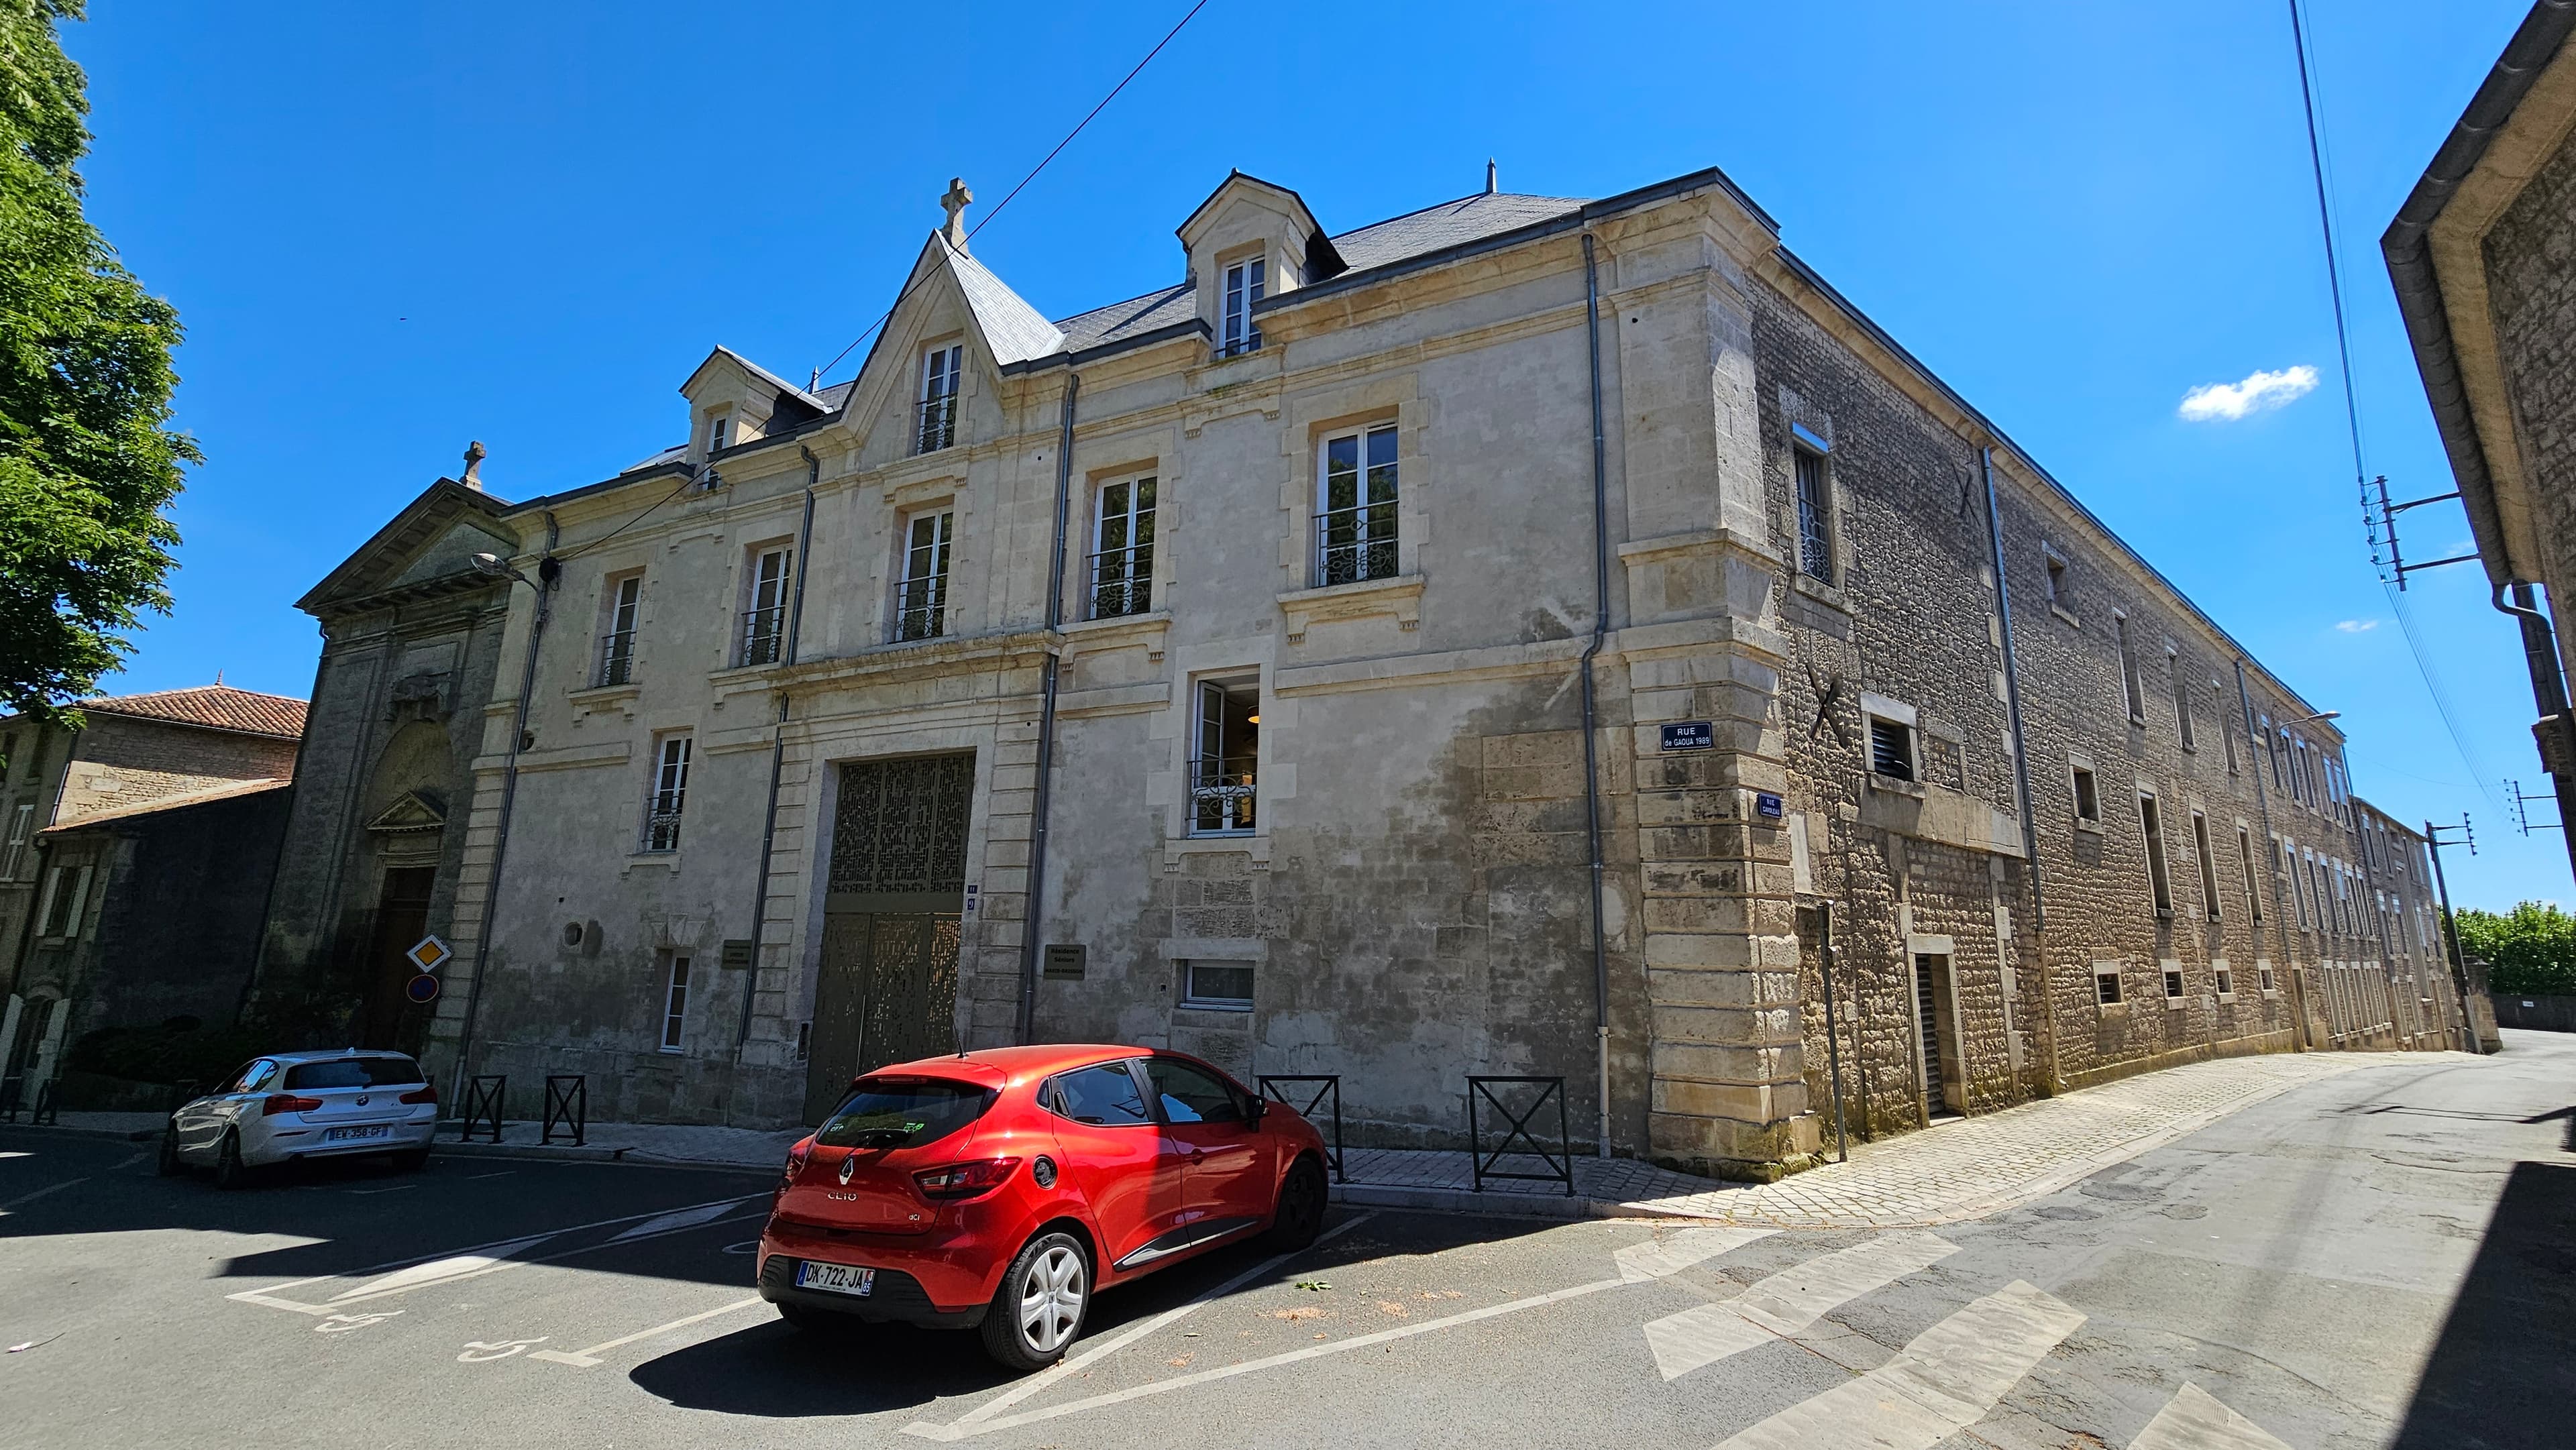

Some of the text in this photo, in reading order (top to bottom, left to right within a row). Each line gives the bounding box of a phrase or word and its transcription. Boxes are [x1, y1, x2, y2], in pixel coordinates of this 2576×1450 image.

[1677, 727, 1695, 736] RUE
[1674, 738, 1694, 746] GAOUA
[1696, 736, 1709, 745] 1989
[969, 900, 973, 909] 9
[806, 1264, 864, 1289] DK-722-JA
